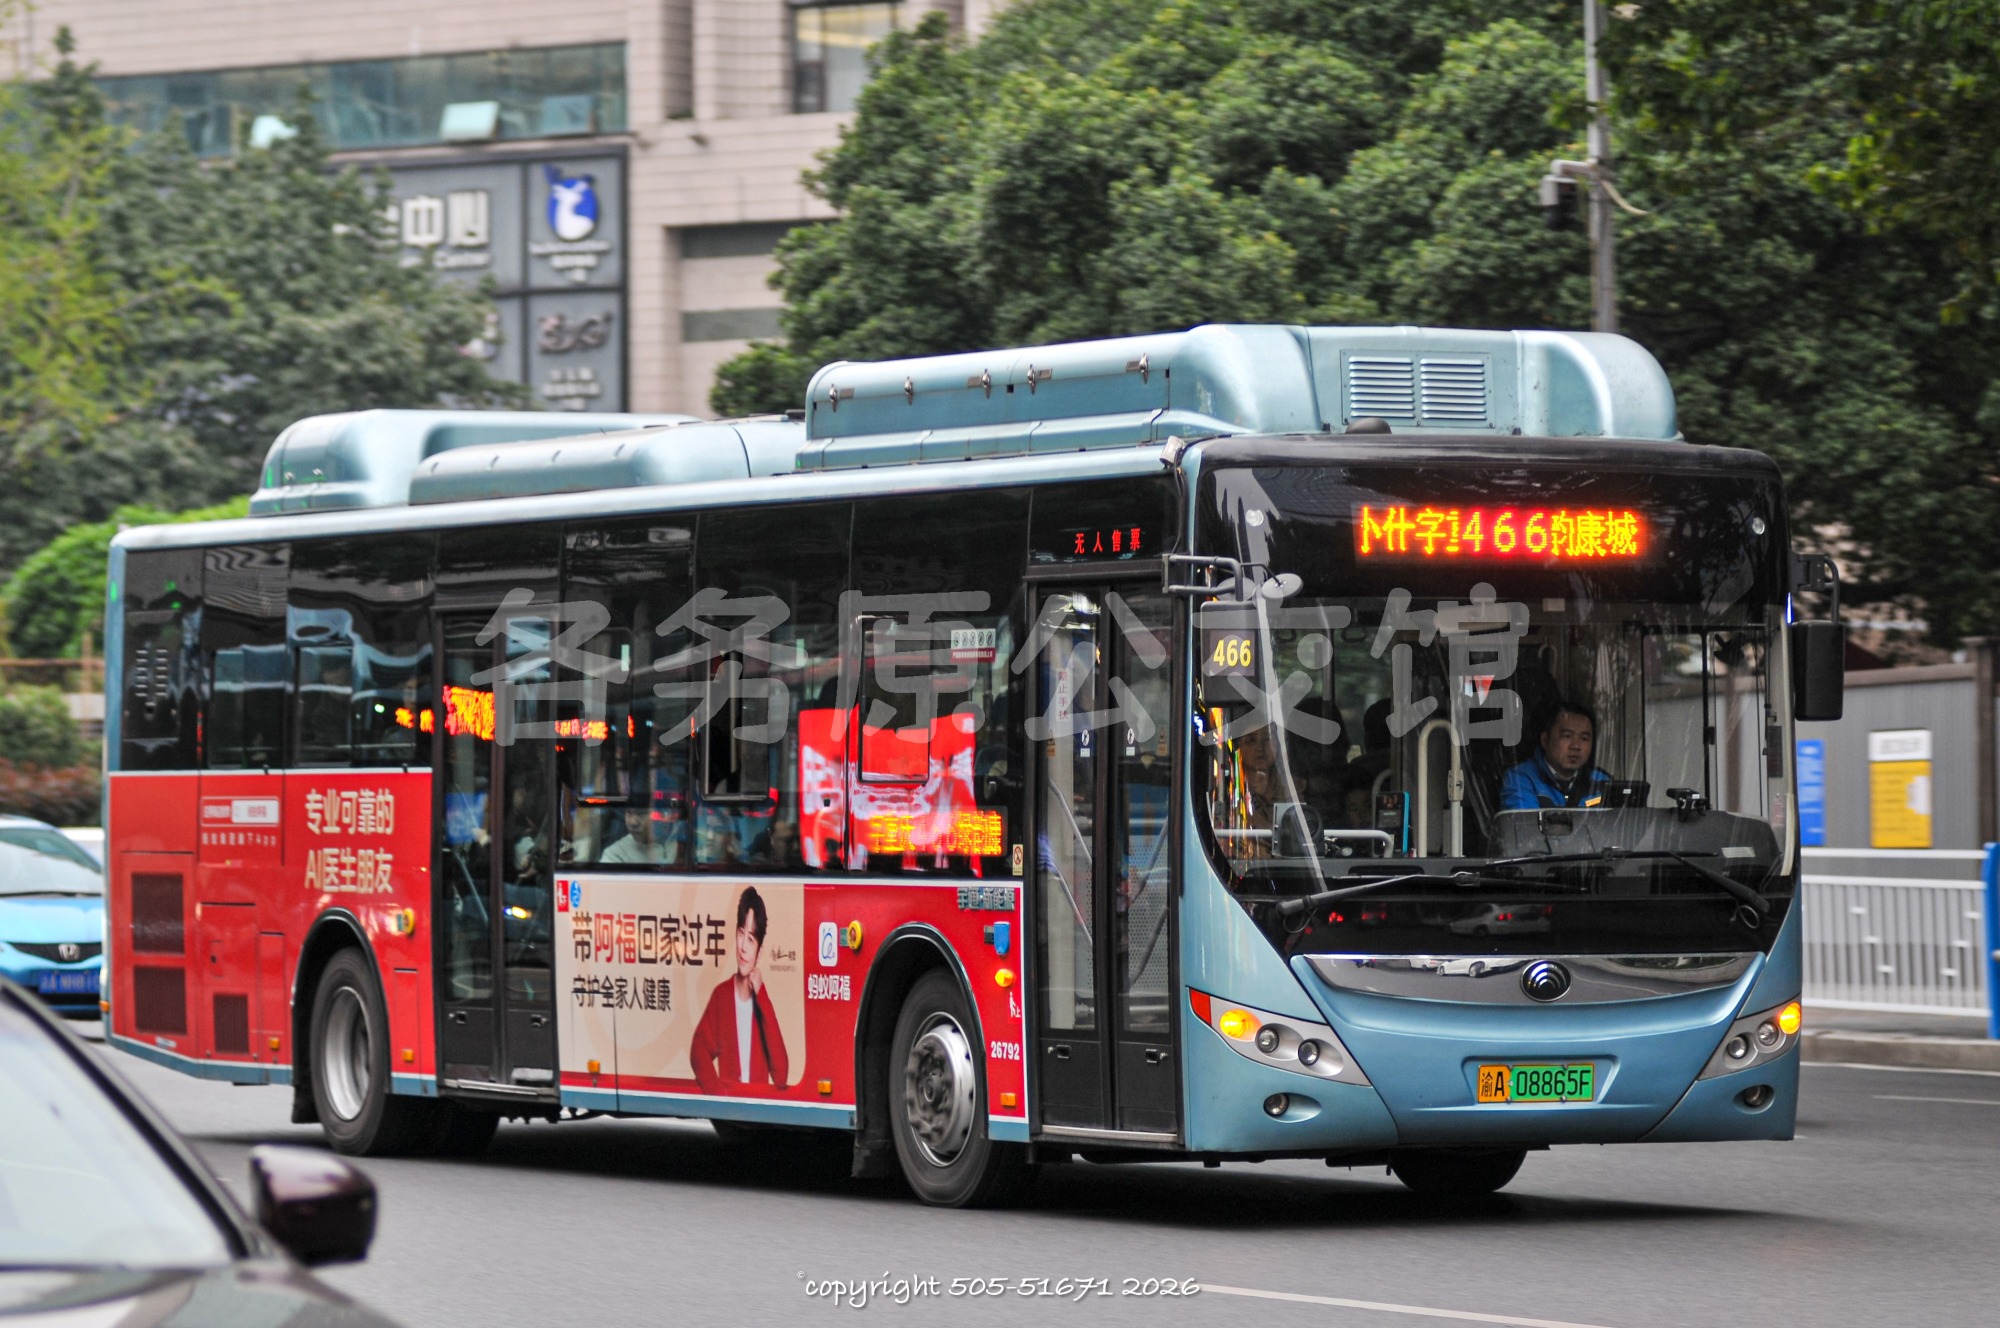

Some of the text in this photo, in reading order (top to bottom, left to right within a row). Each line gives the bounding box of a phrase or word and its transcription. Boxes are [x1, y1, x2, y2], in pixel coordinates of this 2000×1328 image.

[1075, 528, 1140, 554] 无人售票
[1462, 511, 1548, 552] 466
[1213, 639, 1251, 667] 466
[305, 788, 394, 835] 专业可靠的
[304, 847, 394, 894] AI医生朋友
[571, 911, 726, 968] 带阿福回家过年
[572, 974, 671, 1012] 守护全家人健康
[807, 973, 851, 1001] 蚂蚁阿福
[991, 1041, 1020, 1061] 26792
[1516, 1070, 1592, 1097] 08865F
